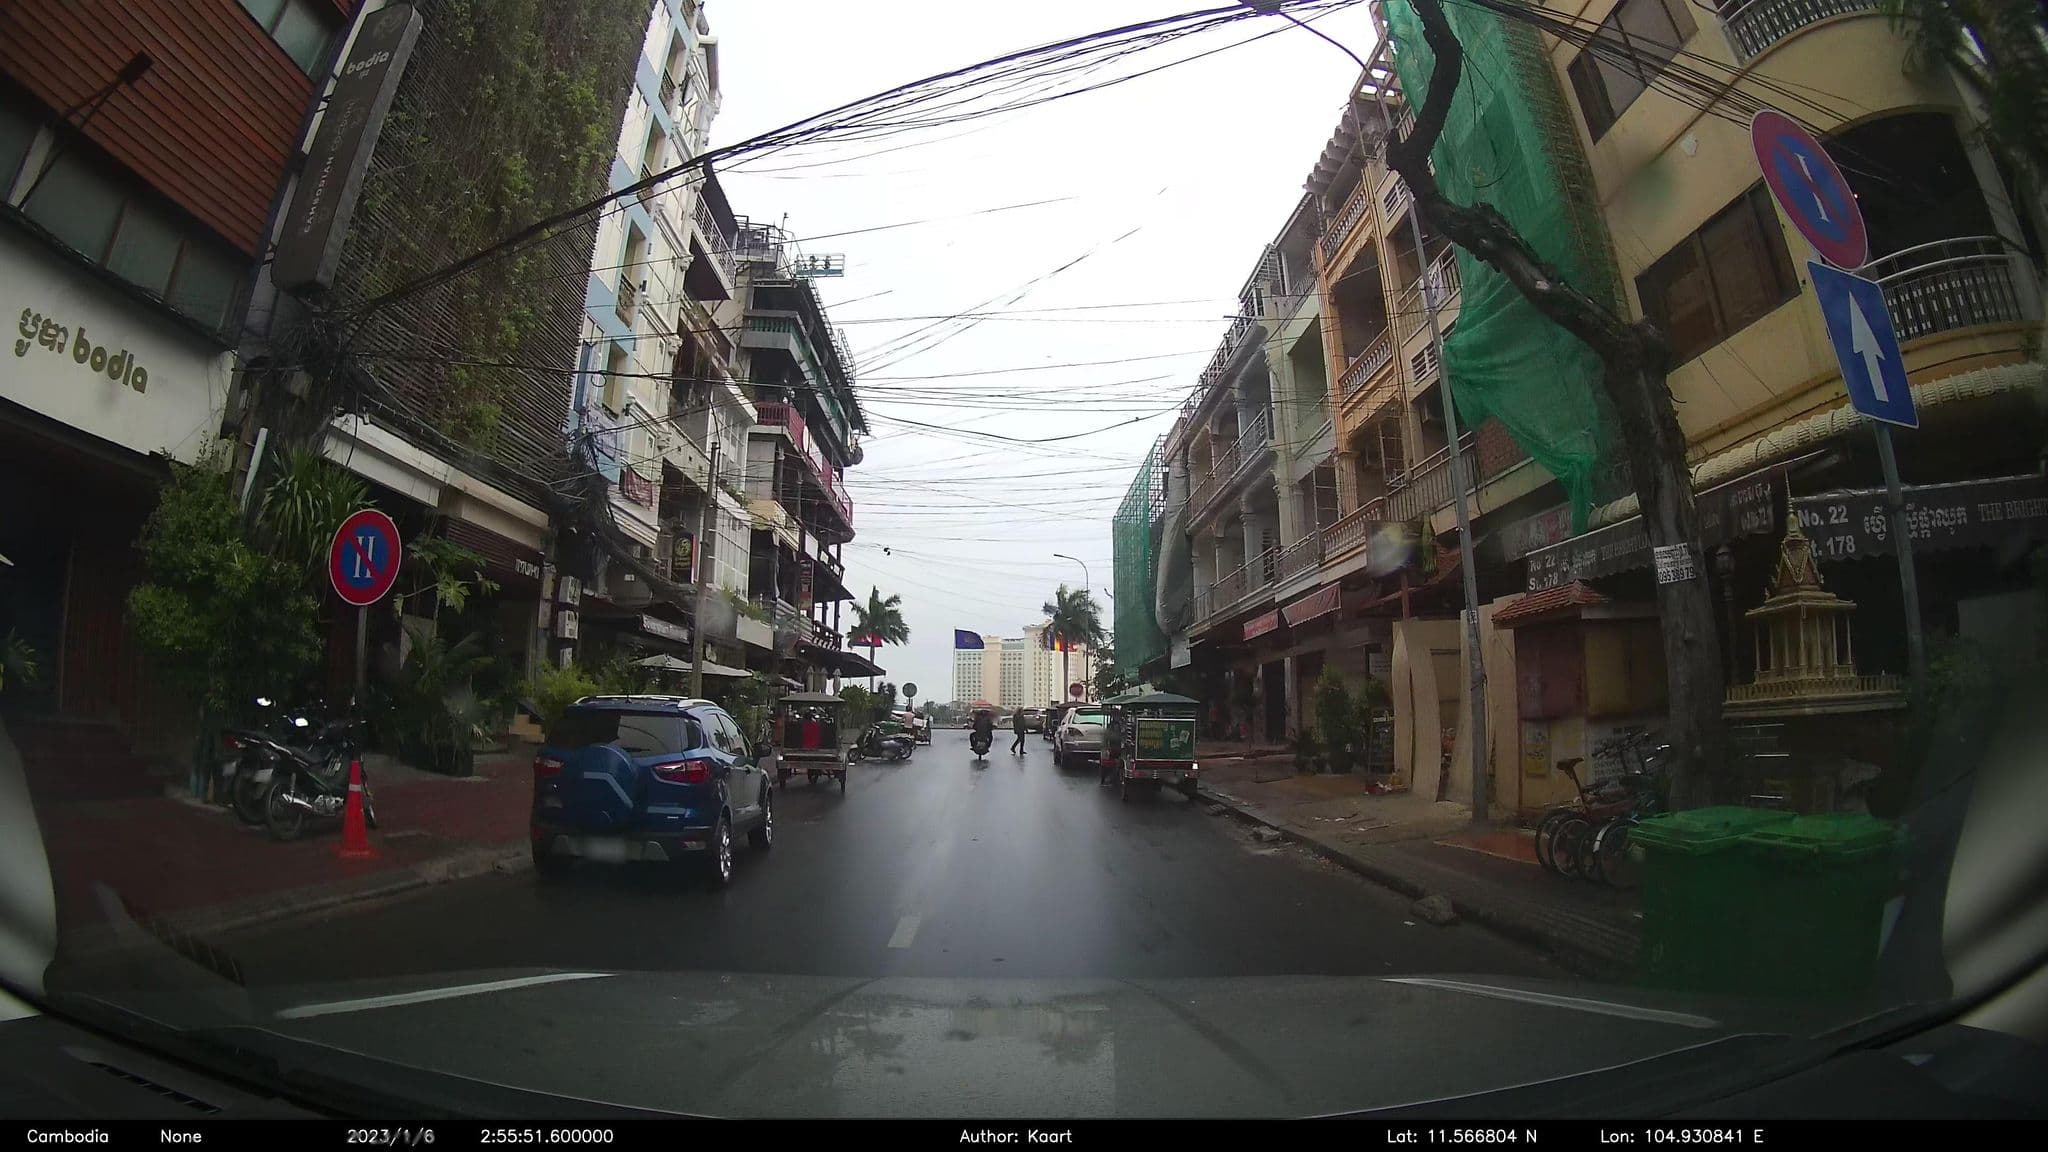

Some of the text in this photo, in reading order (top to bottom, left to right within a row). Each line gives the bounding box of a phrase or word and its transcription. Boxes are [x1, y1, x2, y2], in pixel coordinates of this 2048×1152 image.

[346, 51, 390, 75] bodia
[73, 326, 149, 394] bodia
[1797, 505, 1849, 528] No. 22
[1977, 503, 2003, 522] THE
[1826, 535, 1856, 556] 178
